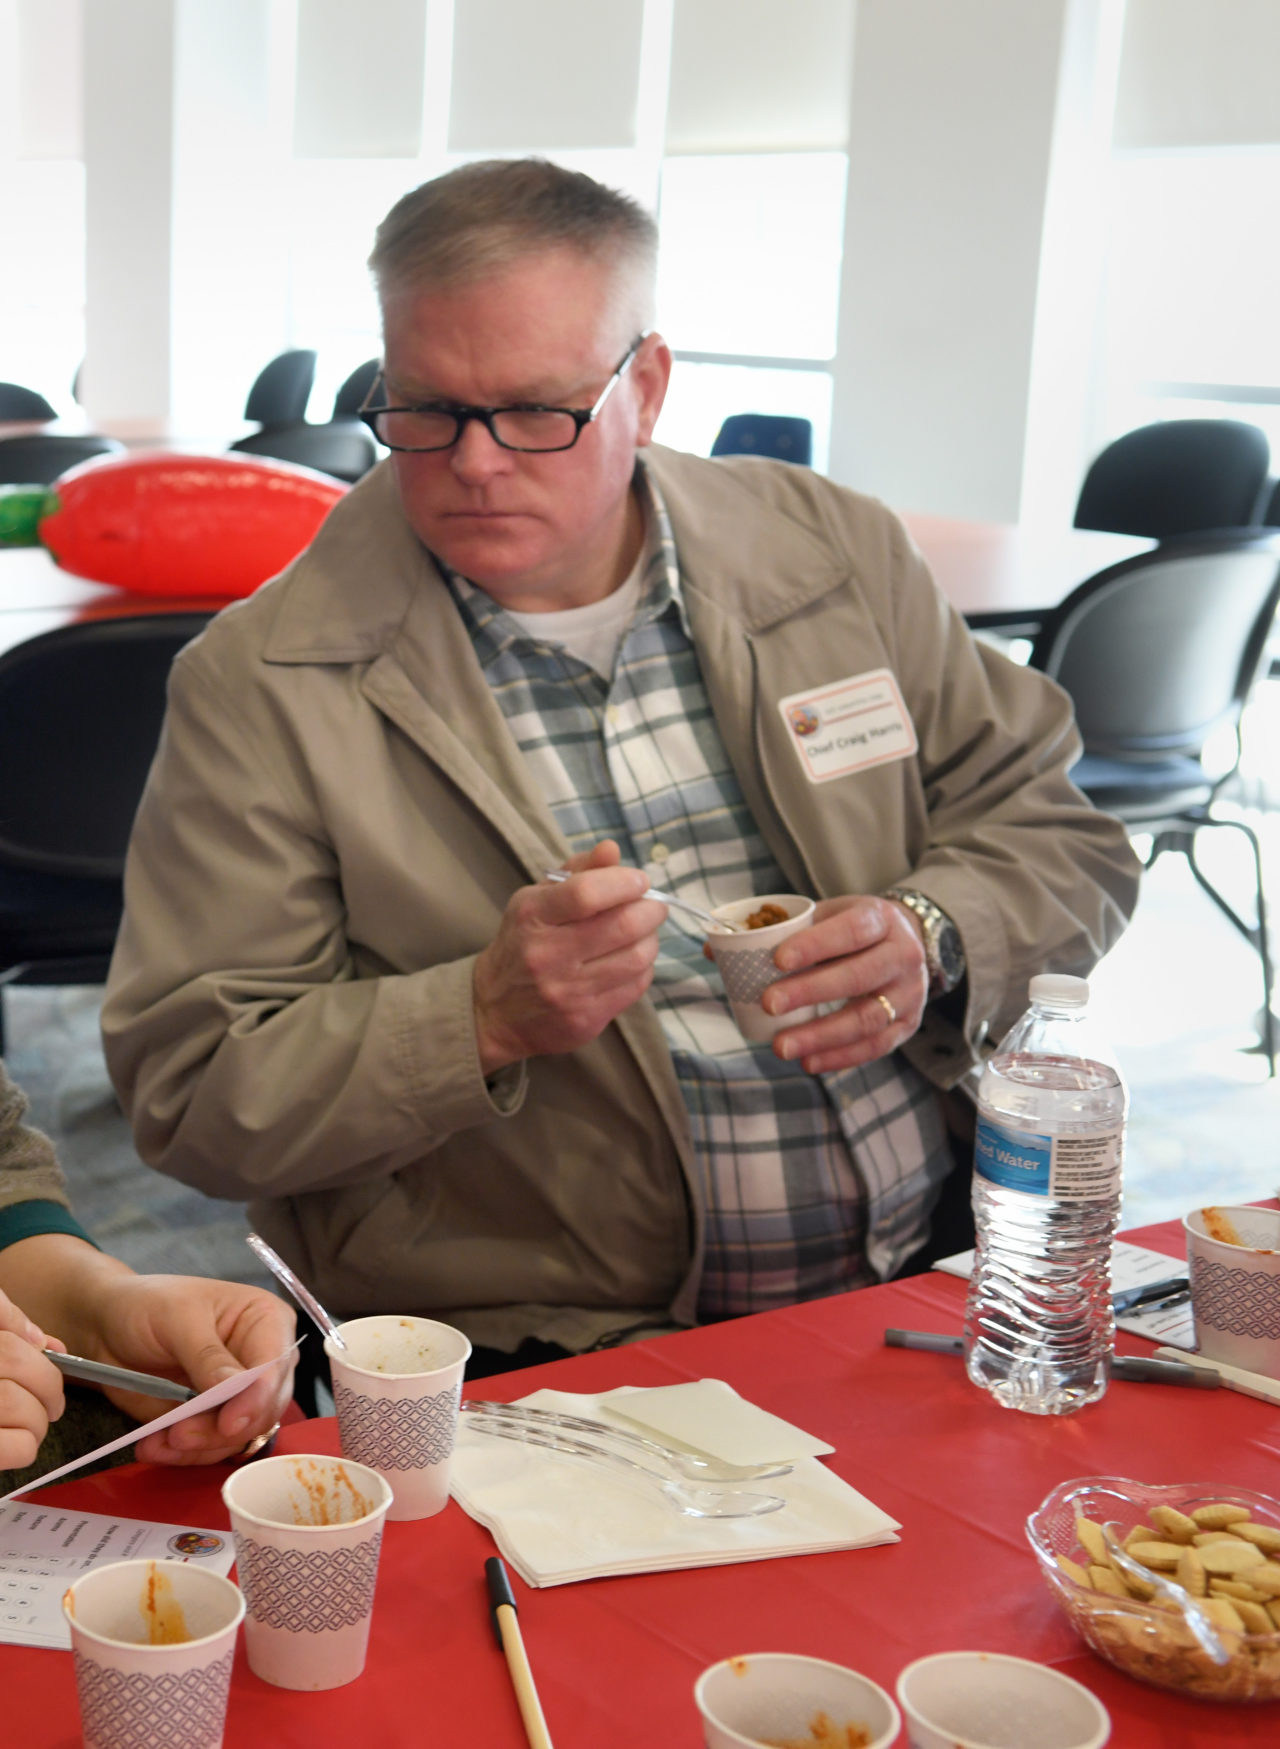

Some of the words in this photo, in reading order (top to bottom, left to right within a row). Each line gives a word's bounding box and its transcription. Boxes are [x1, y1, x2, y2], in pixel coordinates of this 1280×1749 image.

[807, 740, 834, 757] Chief
[836, 733, 868, 750] Craig
[996, 1148, 1041, 1171] Water
[11, 1511, 28, 1522] Taste
[28, 1514, 48, 1530] Texture
[50, 1517, 68, 1531] Aroma
[61, 1520, 89, 1547] Presentation
